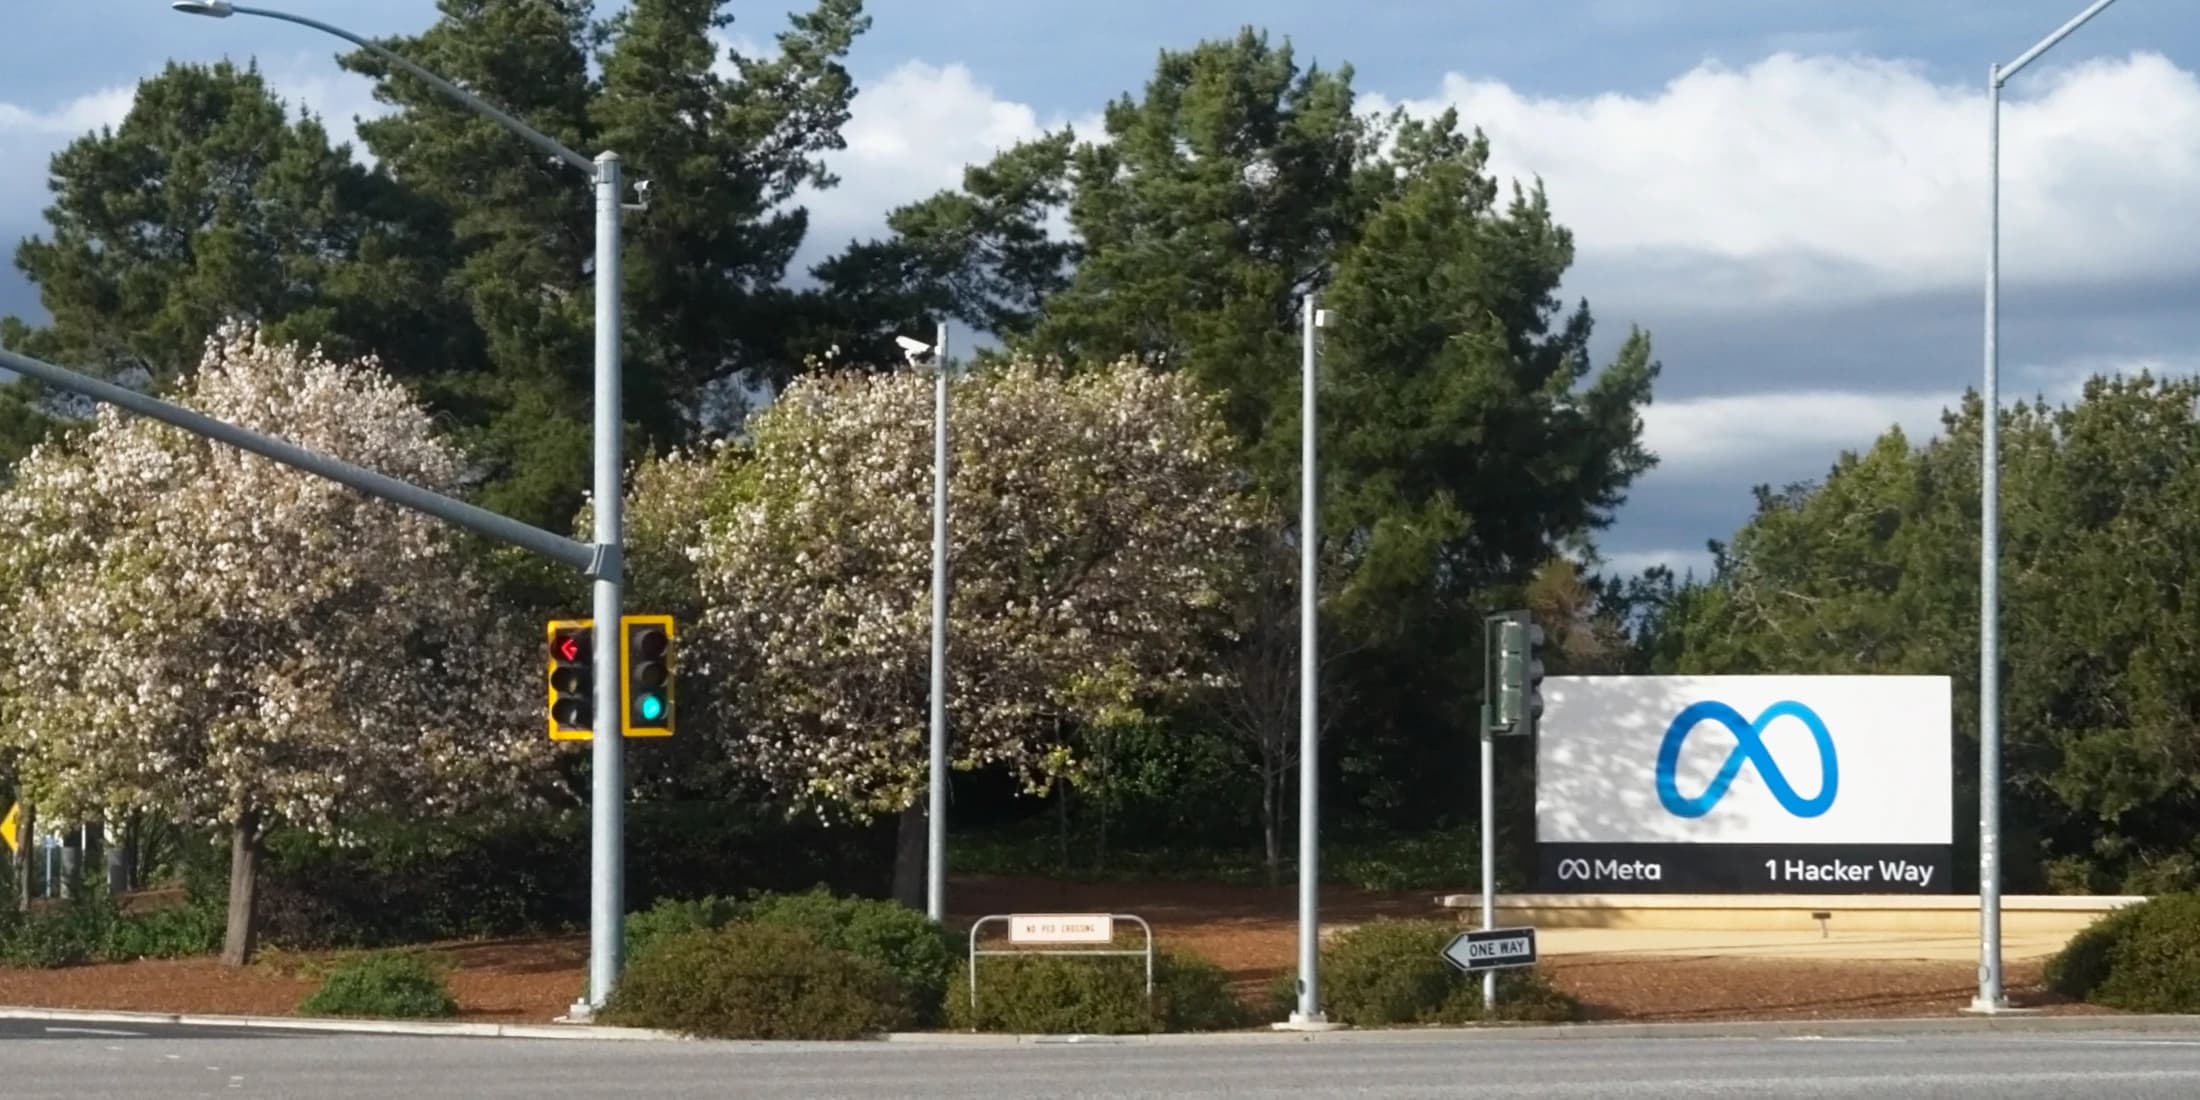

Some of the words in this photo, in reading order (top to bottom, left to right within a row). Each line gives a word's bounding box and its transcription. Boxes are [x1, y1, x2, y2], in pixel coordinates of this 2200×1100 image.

[1594, 859, 1661, 880] Meta
[1765, 859, 1777, 880] 1
[1784, 859, 1873, 881] Hacker
[1880, 859, 1934, 886] Way
[1026, 924, 1036, 933] NO
[1469, 942, 1496, 957] ONE
[1500, 940, 1525, 954] WAY
